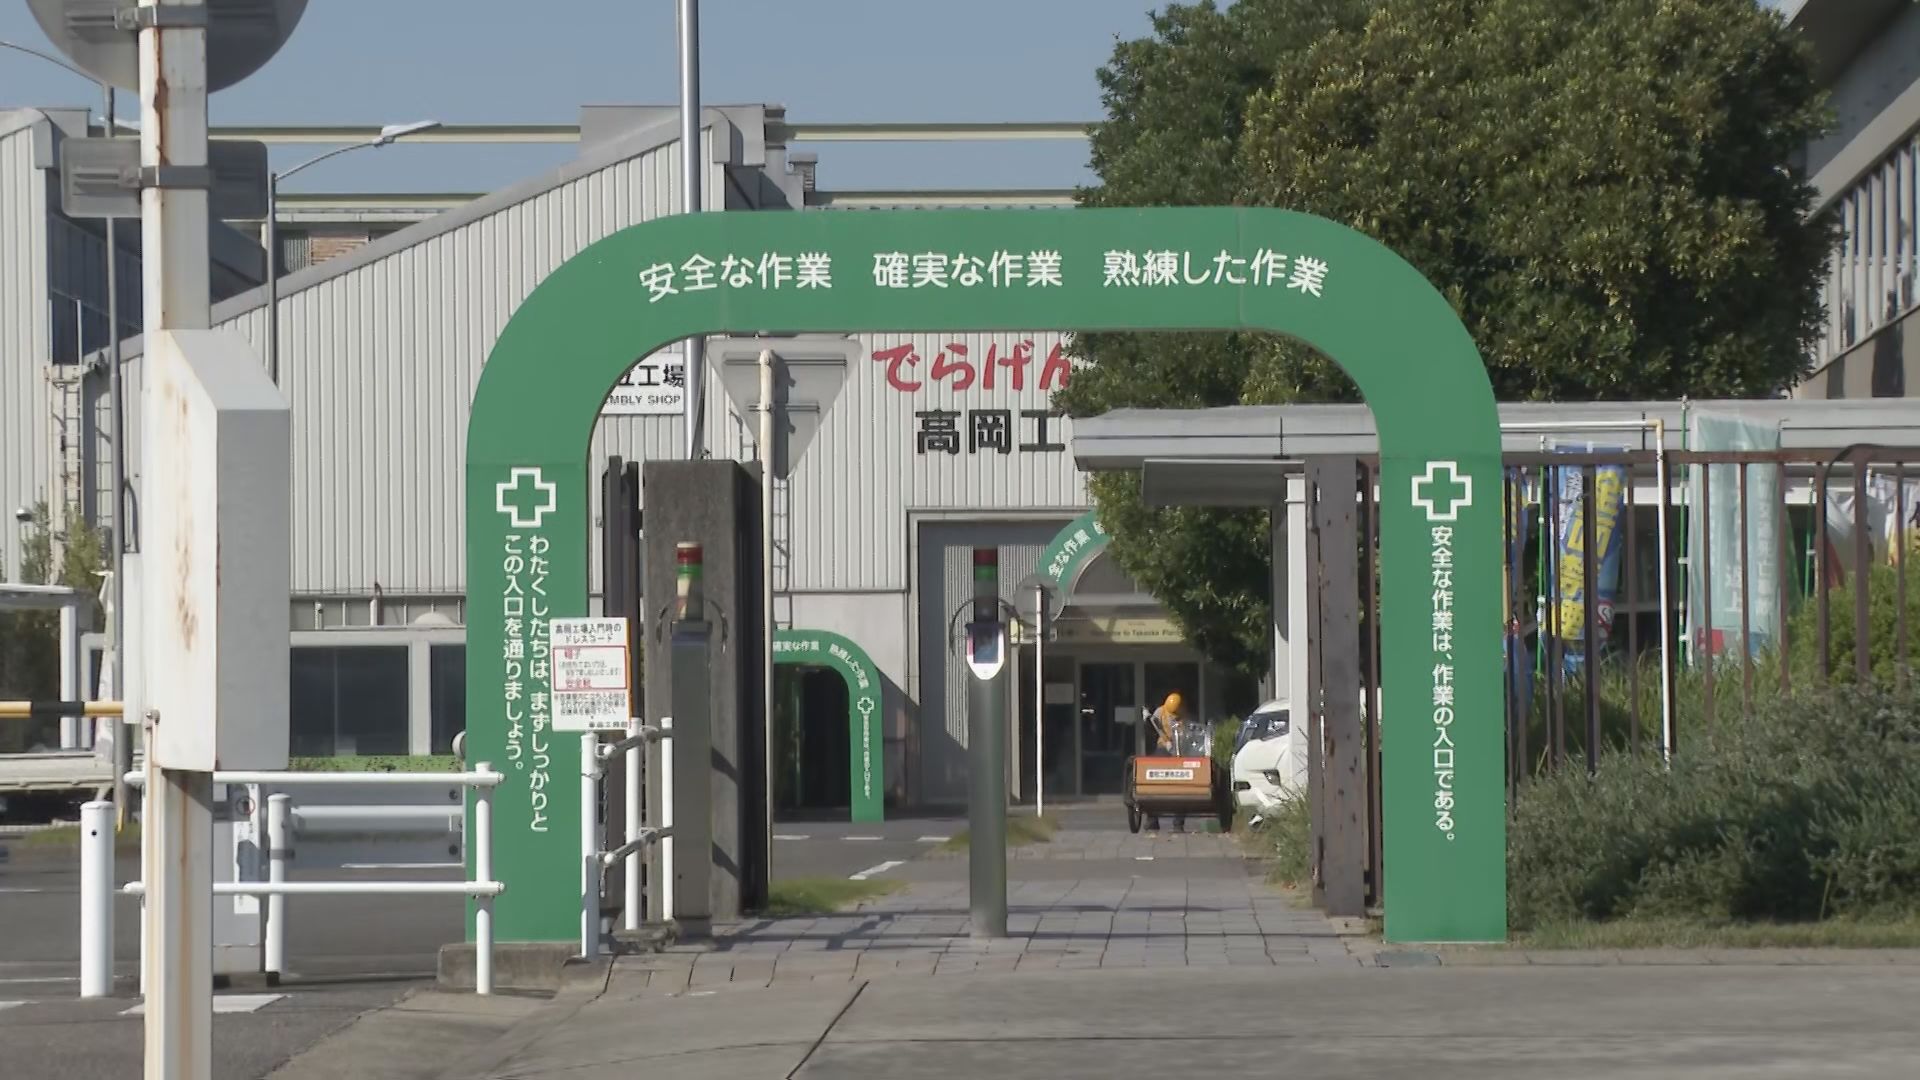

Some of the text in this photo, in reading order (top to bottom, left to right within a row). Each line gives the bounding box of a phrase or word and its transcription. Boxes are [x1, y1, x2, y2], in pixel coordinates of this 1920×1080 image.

[639, 248, 1328, 303] 安全な作業 確実な作業 熟練した作業
[647, 394, 681, 405] SHOP
[914, 409, 1066, 455] 高岡工
[503, 534, 525, 770] この入口を通りましょう。
[529, 534, 551, 832] わたくしたちは、まずしっかりと
[1431, 525, 1455, 842] 安全な作業は、作業の入口である。
